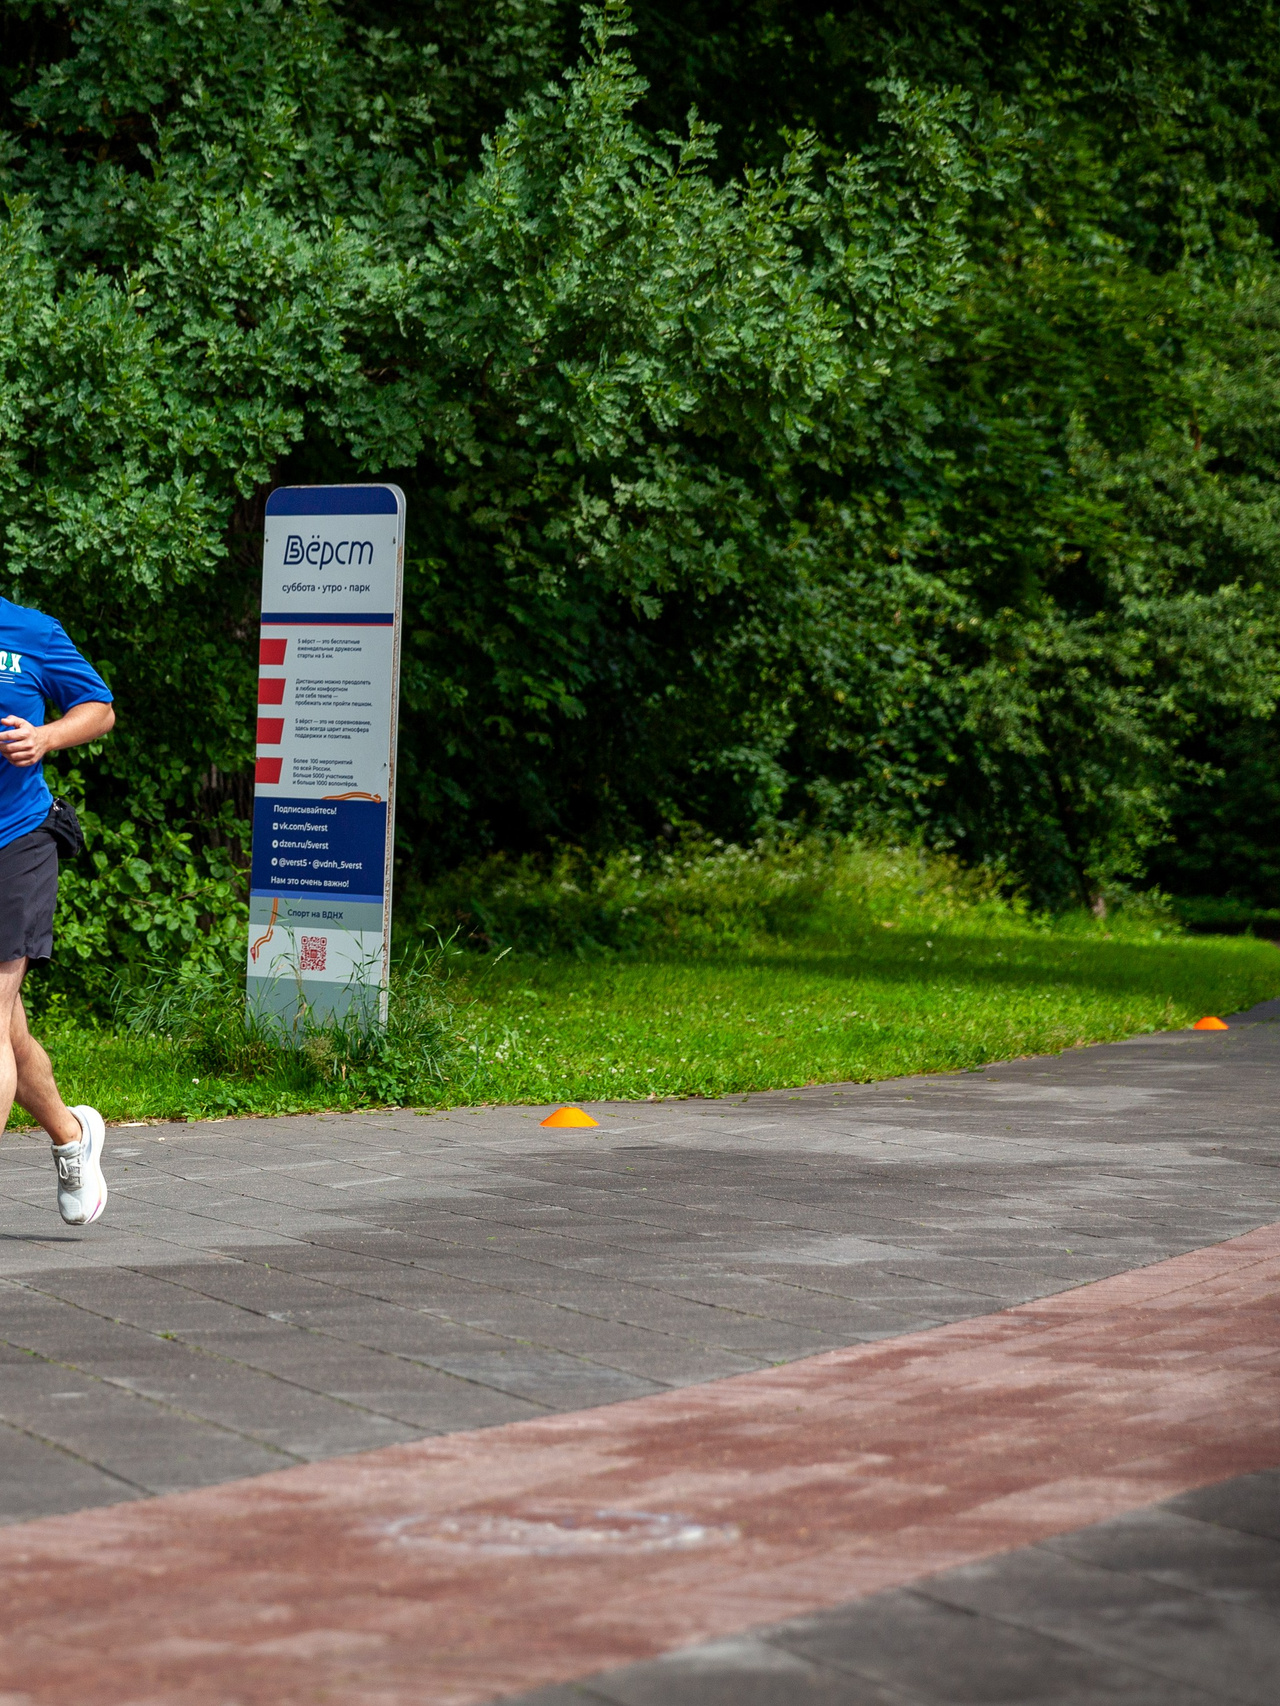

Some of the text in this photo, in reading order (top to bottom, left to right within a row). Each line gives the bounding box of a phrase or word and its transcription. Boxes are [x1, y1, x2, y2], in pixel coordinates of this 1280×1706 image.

[282, 582, 370, 594] суббота утро парк
[274, 805, 337, 815] Подписывайтесь!
[280, 822, 328, 832] vk.com/5verst
[279, 839, 329, 849] dzen.ru/5verst
[279, 858, 362, 870] @verst5 @vdnh_5verst
[271, 876, 286, 884] Нам
[300, 878, 322, 886] очень
[287, 909, 310, 918] Спорт
[322, 911, 343, 919] ВДНХ
